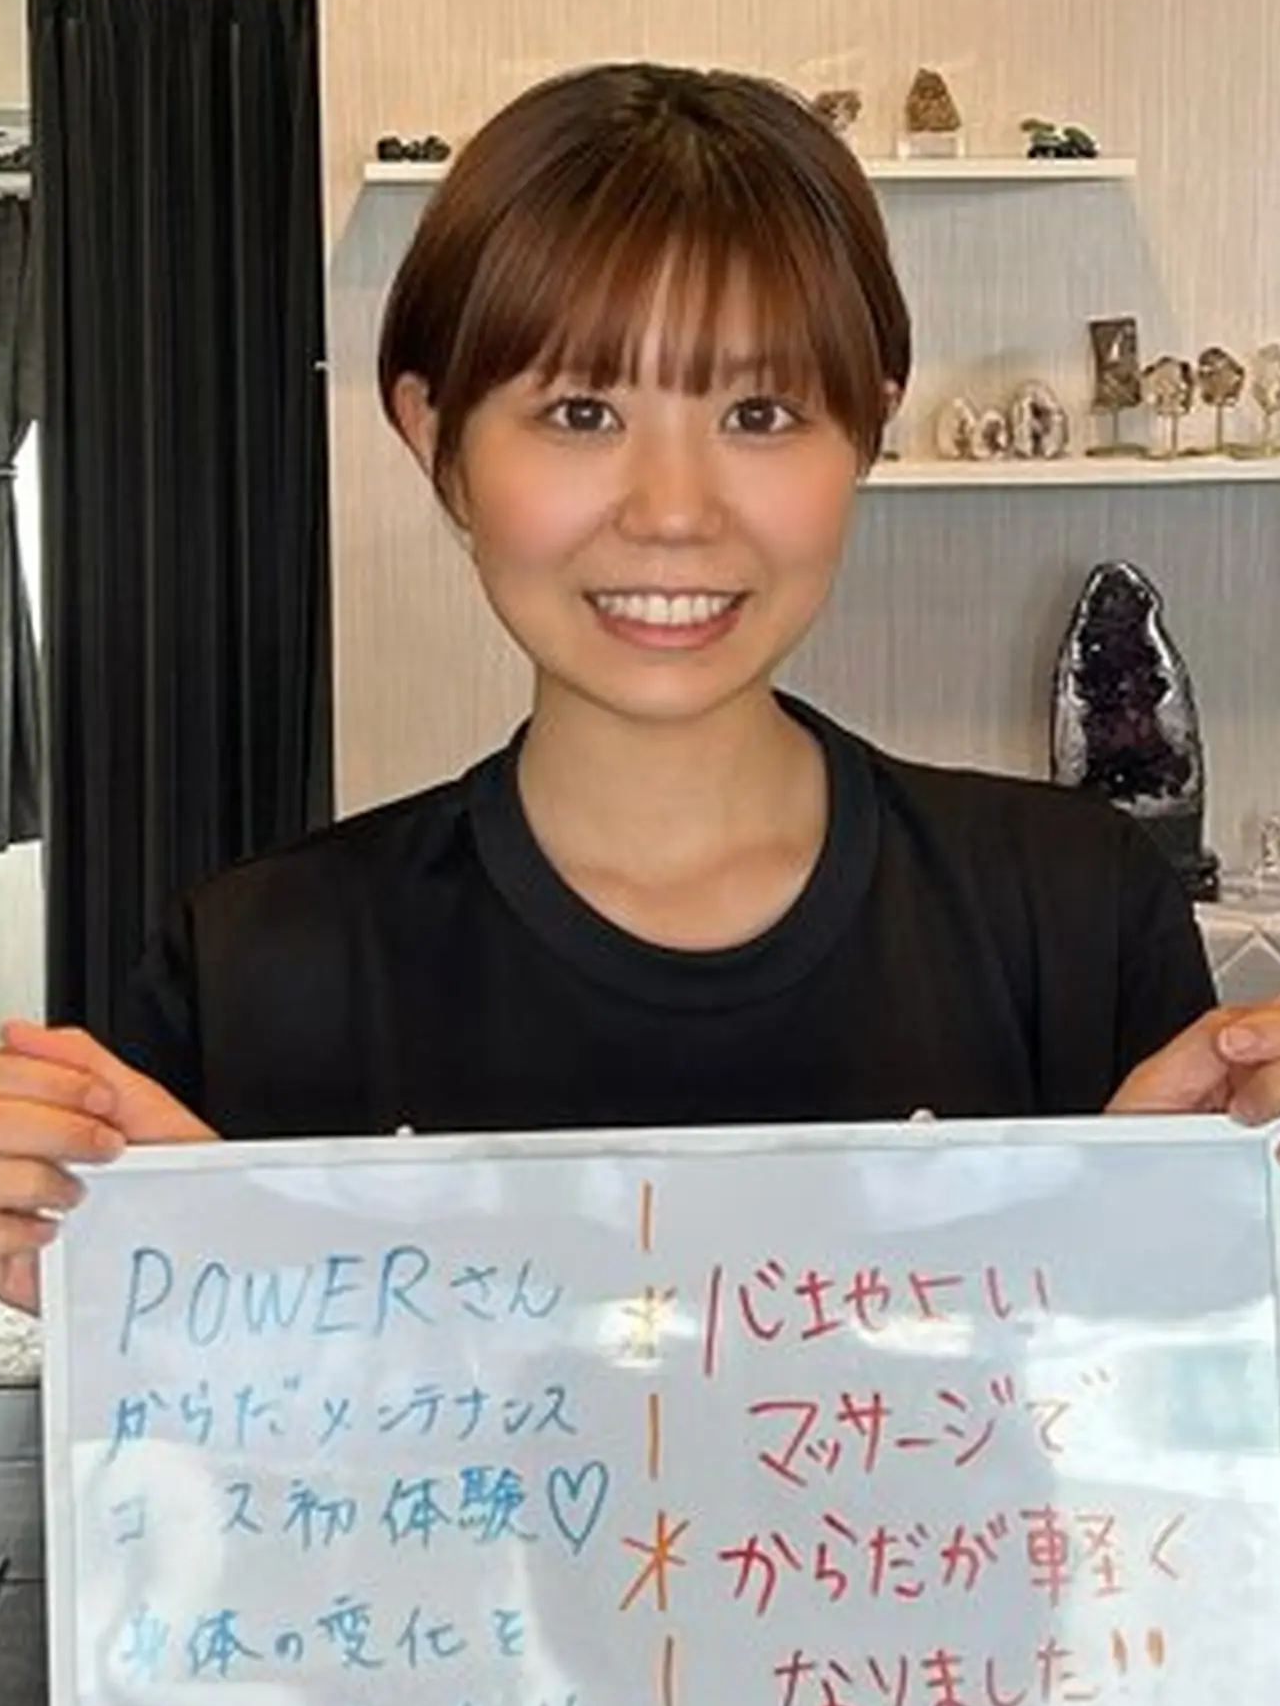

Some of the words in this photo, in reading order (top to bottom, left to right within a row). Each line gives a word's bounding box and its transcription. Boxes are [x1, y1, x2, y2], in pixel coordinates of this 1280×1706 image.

[118, 1245, 565, 1356] POWERさん
[100, 1373, 580, 1469] からだメンテナンス
[746, 1367, 1112, 1487] マッサージで
[717, 1503, 1187, 1617] からだが軽く
